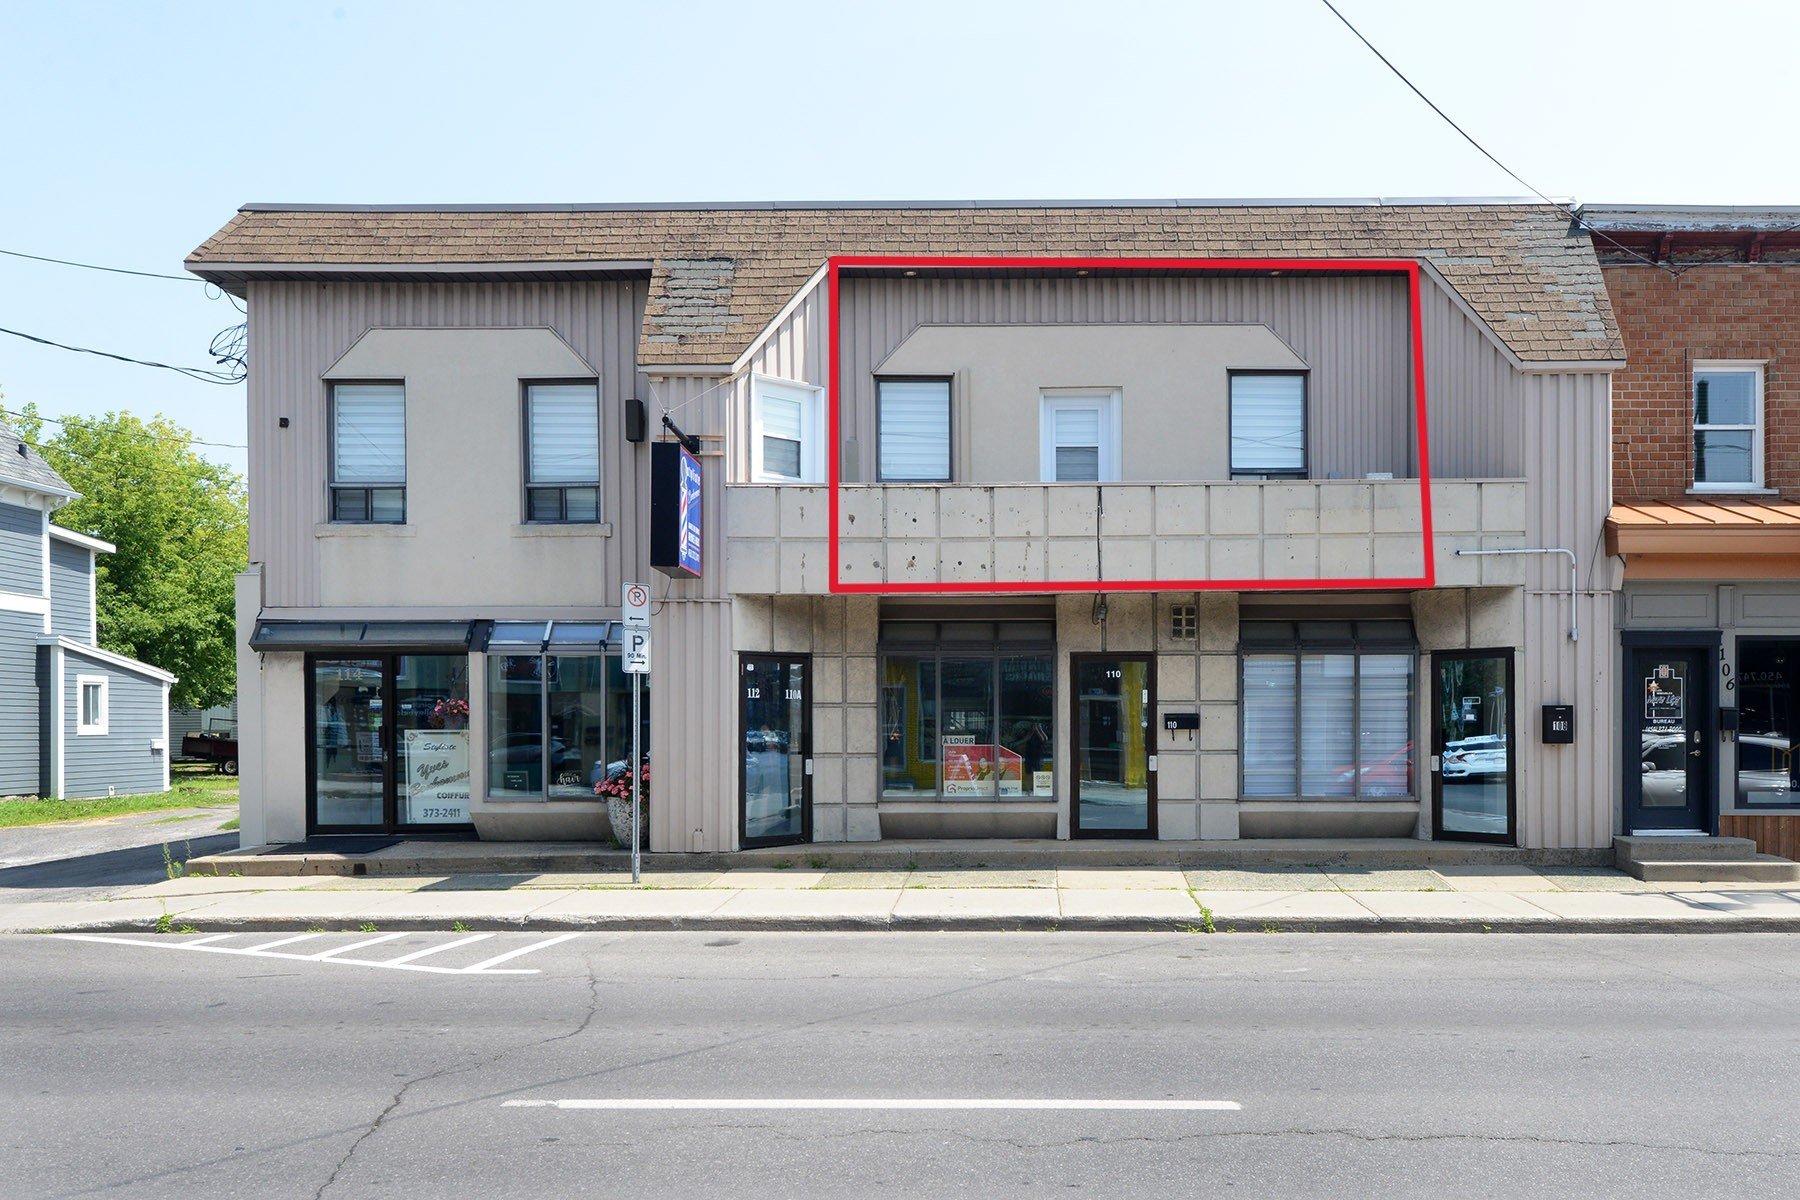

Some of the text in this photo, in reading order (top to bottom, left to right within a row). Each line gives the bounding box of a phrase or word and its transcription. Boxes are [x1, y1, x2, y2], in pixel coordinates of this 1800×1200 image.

[632, 635, 644, 652] P
[336, 668, 364, 681] 114
[1105, 670, 1122, 678] 110
[1719, 647, 1736, 691] 106
[747, 687, 760, 699] 112
[785, 688, 802, 700] 110A
[1167, 720, 1178, 729] 110
[1552, 720, 1568, 731] 108
[949, 737, 974, 745] LOUER
[423, 742, 457, 752] Styliste
[423, 808, 461, 818] 373-2411
